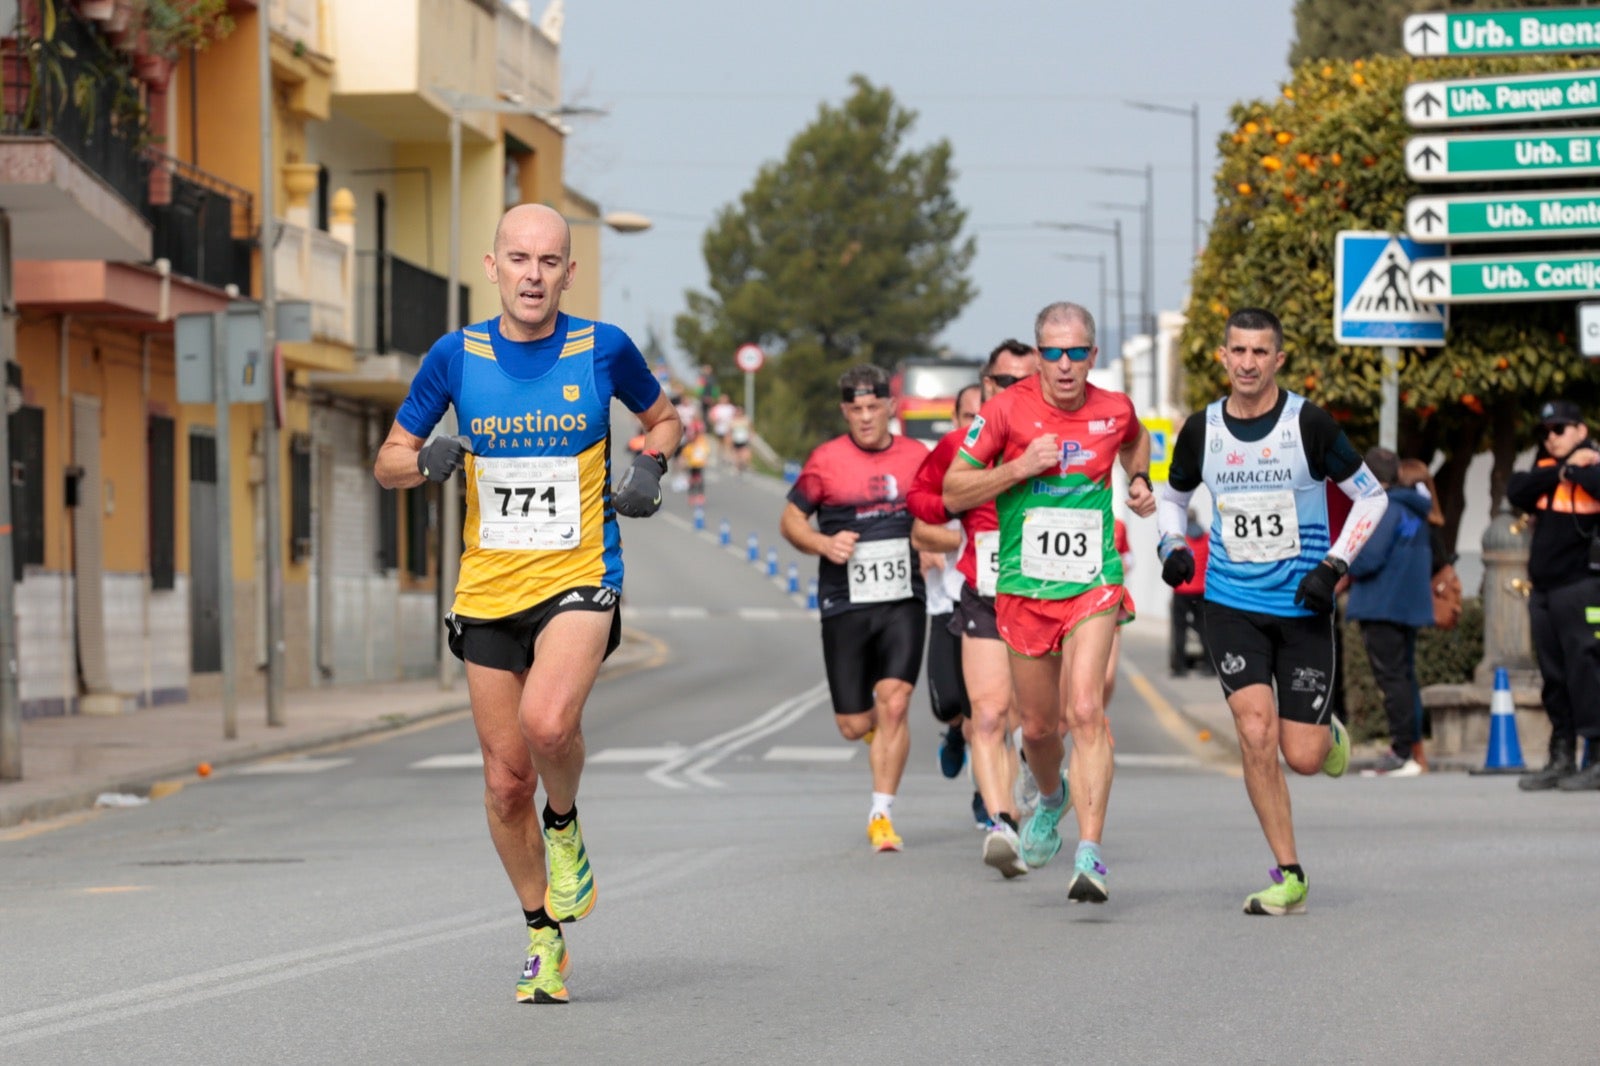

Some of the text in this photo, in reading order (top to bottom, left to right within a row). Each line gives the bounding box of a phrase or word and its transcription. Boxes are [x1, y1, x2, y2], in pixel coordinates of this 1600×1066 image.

[1453, 19, 1514, 49] Urb.
[1450, 80, 1598, 112] Urb. Parque del
[1515, 140, 1563, 165] Urb.
[1568, 138, 1592, 163] El
[1486, 201, 1600, 228] Urb. Mont
[1481, 264, 1530, 289] Urb.
[471, 409, 587, 441] agustinos
[488, 436, 569, 449] GRANADA
[1216, 468, 1292, 484] MARACENA
[494, 486, 556, 517] 771
[1234, 514, 1284, 538] 813
[1037, 530, 1087, 557] 103
[853, 559, 907, 584] 3135
